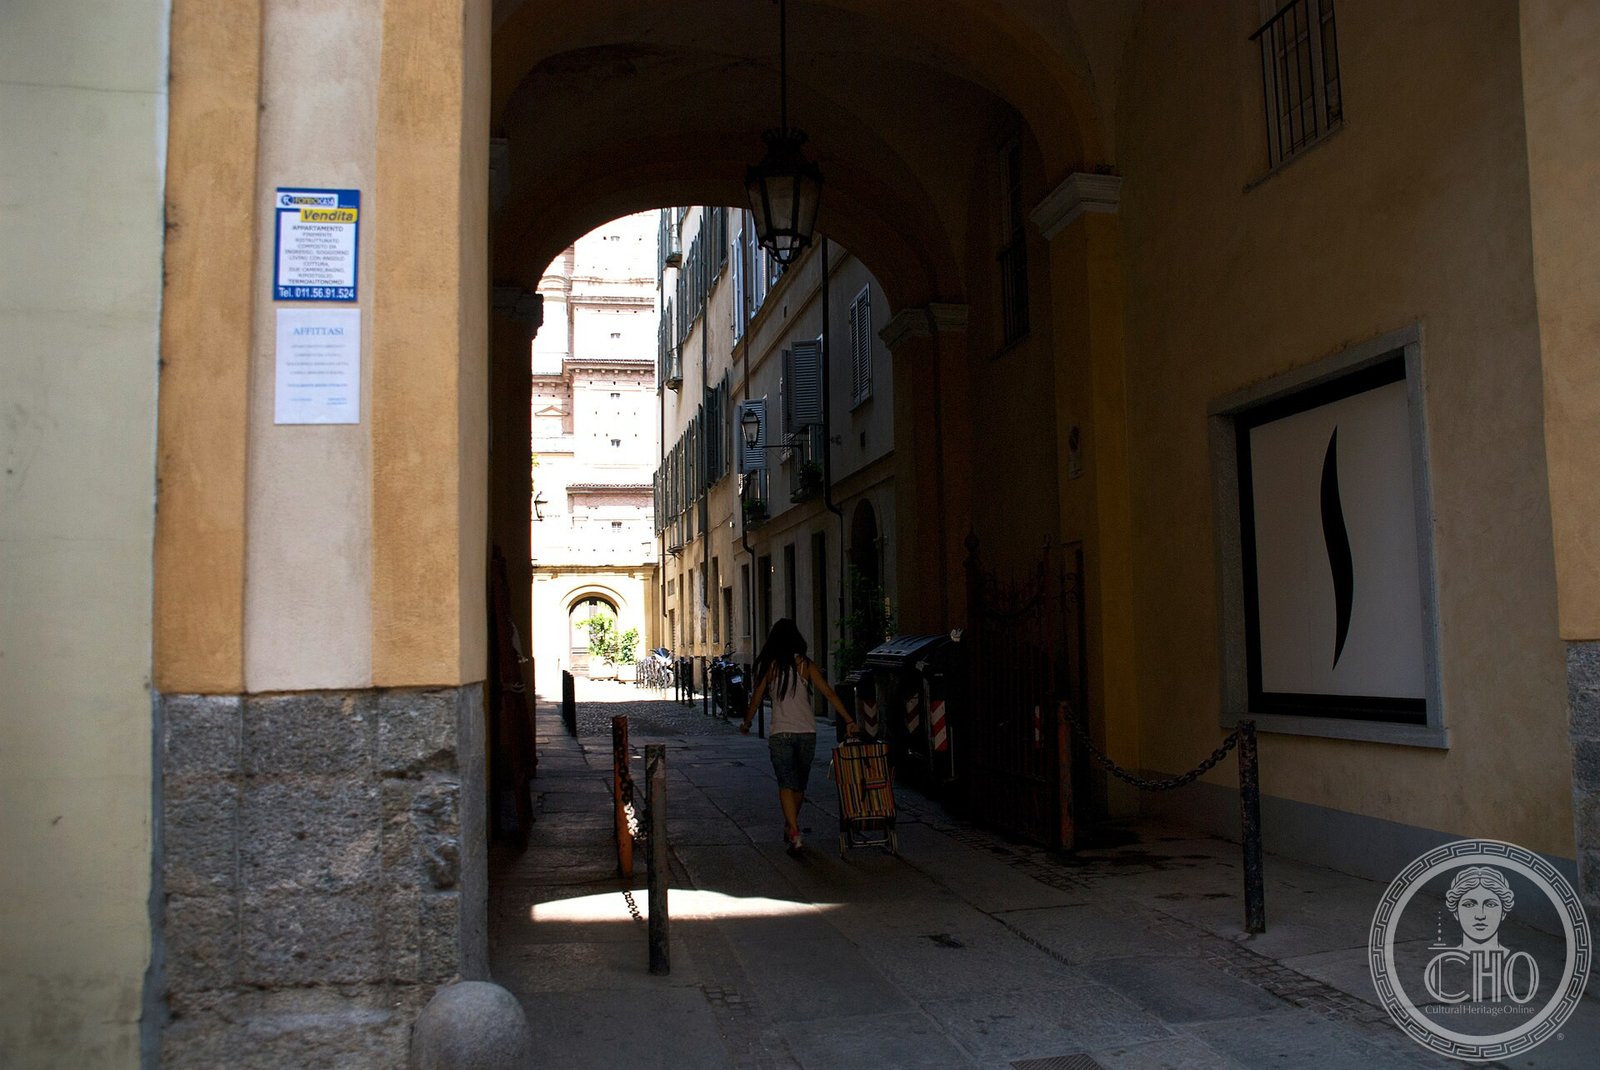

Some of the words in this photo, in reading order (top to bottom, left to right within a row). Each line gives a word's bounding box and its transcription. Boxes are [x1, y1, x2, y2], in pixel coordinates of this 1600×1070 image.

[304, 209, 353, 221] Vendita
[279, 287, 294, 298] Tel.
[295, 287, 354, 299] 011.56.91.524
[293, 327, 344, 336] AFFITTASI
